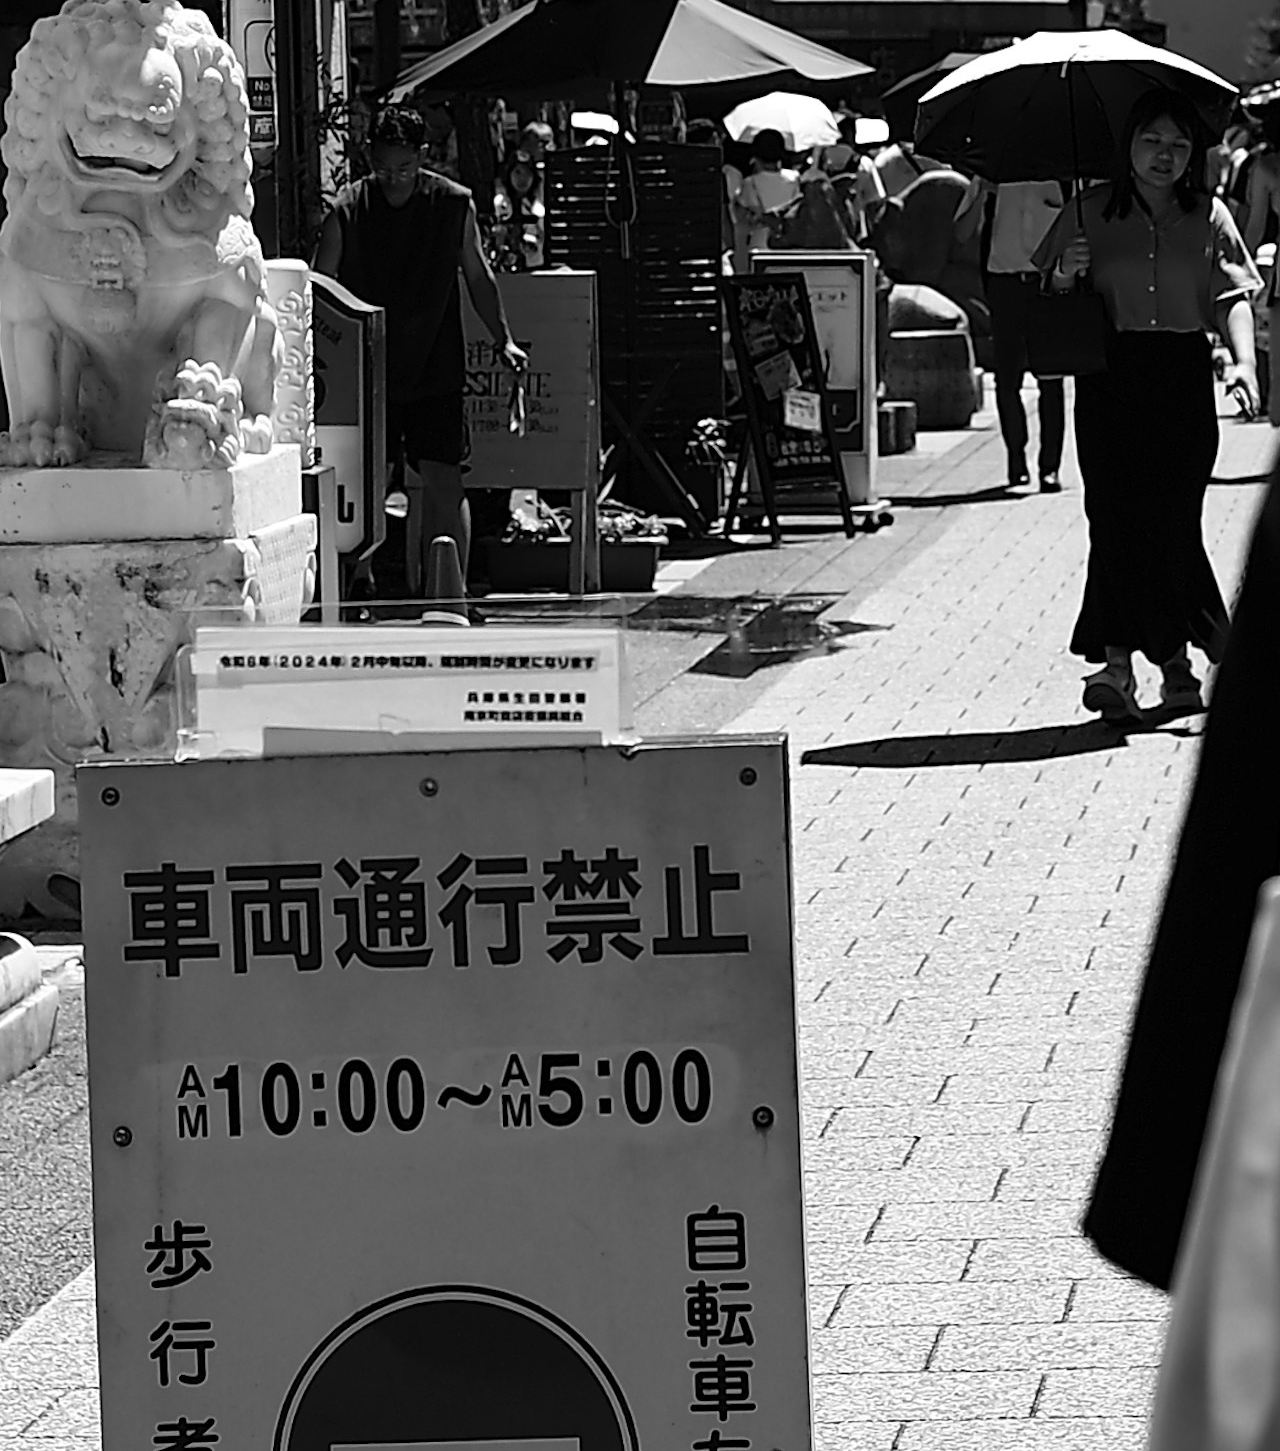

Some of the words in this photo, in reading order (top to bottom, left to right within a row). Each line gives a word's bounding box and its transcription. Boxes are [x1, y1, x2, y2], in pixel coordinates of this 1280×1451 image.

[122, 844, 751, 979] 車両通行禁止
